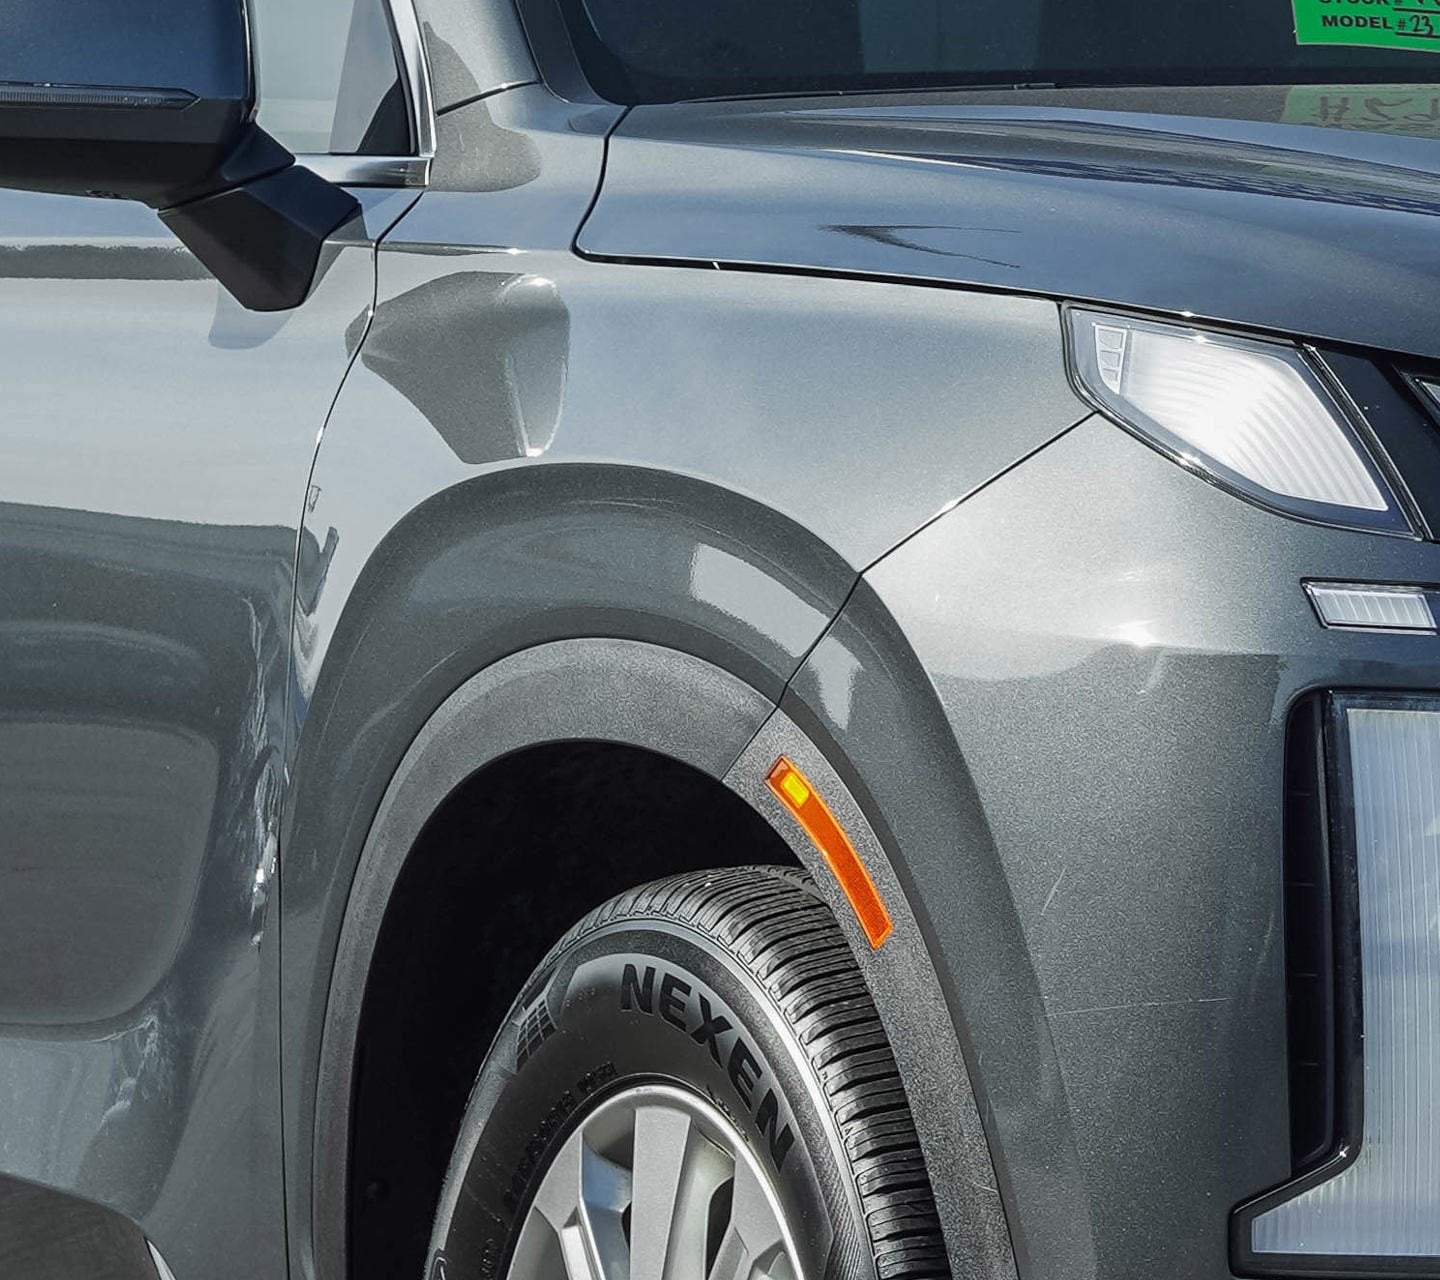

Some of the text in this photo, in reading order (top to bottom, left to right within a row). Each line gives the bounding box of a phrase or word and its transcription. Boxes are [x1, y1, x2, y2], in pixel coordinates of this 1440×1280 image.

[1322, 15, 1393, 30] MODEL
[1411, 14, 1433, 37] 23
[620, 964, 795, 1173] NEXEN
